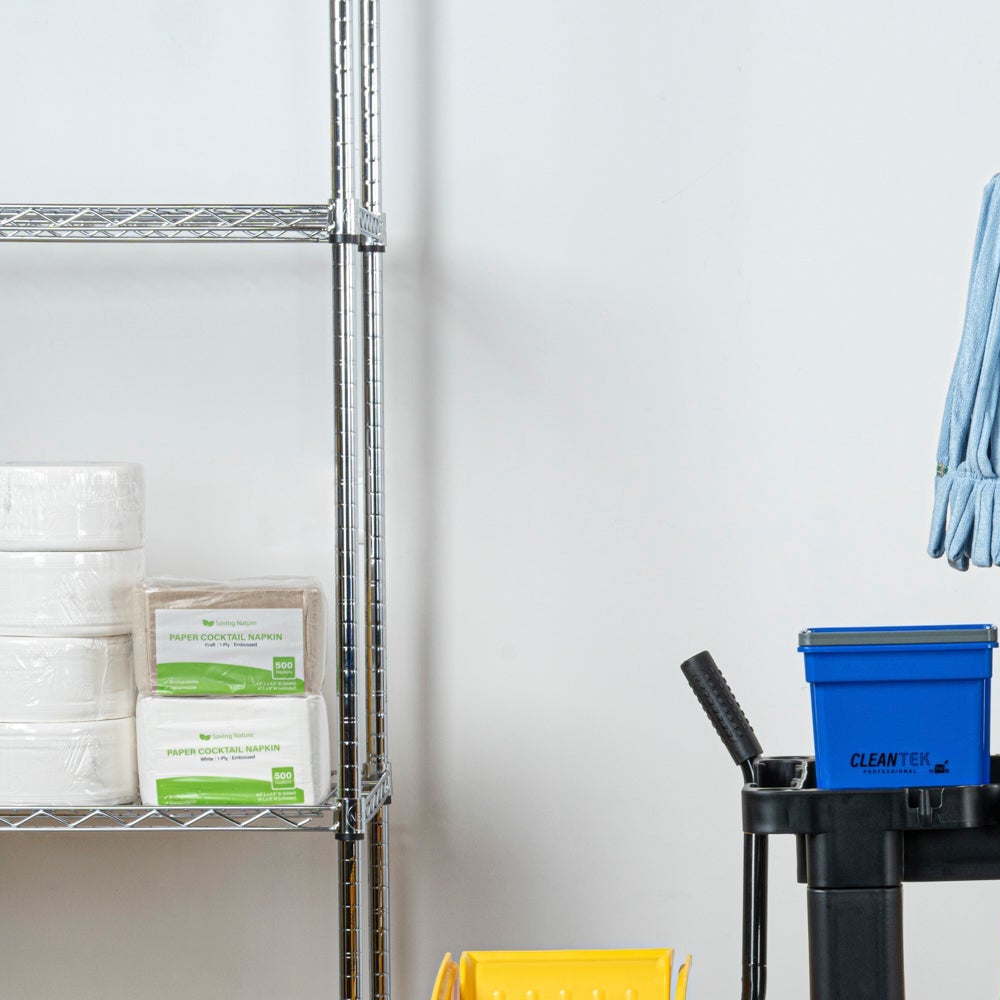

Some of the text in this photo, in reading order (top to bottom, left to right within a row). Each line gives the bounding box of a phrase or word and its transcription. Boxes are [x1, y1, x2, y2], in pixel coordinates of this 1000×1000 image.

[169, 633, 283, 641] PAPER COCKTAIL NAPKIN
[275, 661, 293, 669] 500
[167, 744, 280, 757] PAPER COCKTAIL NAPKIN
[850, 752, 931, 768] CLEANTEK
[274, 771, 292, 780] 500
